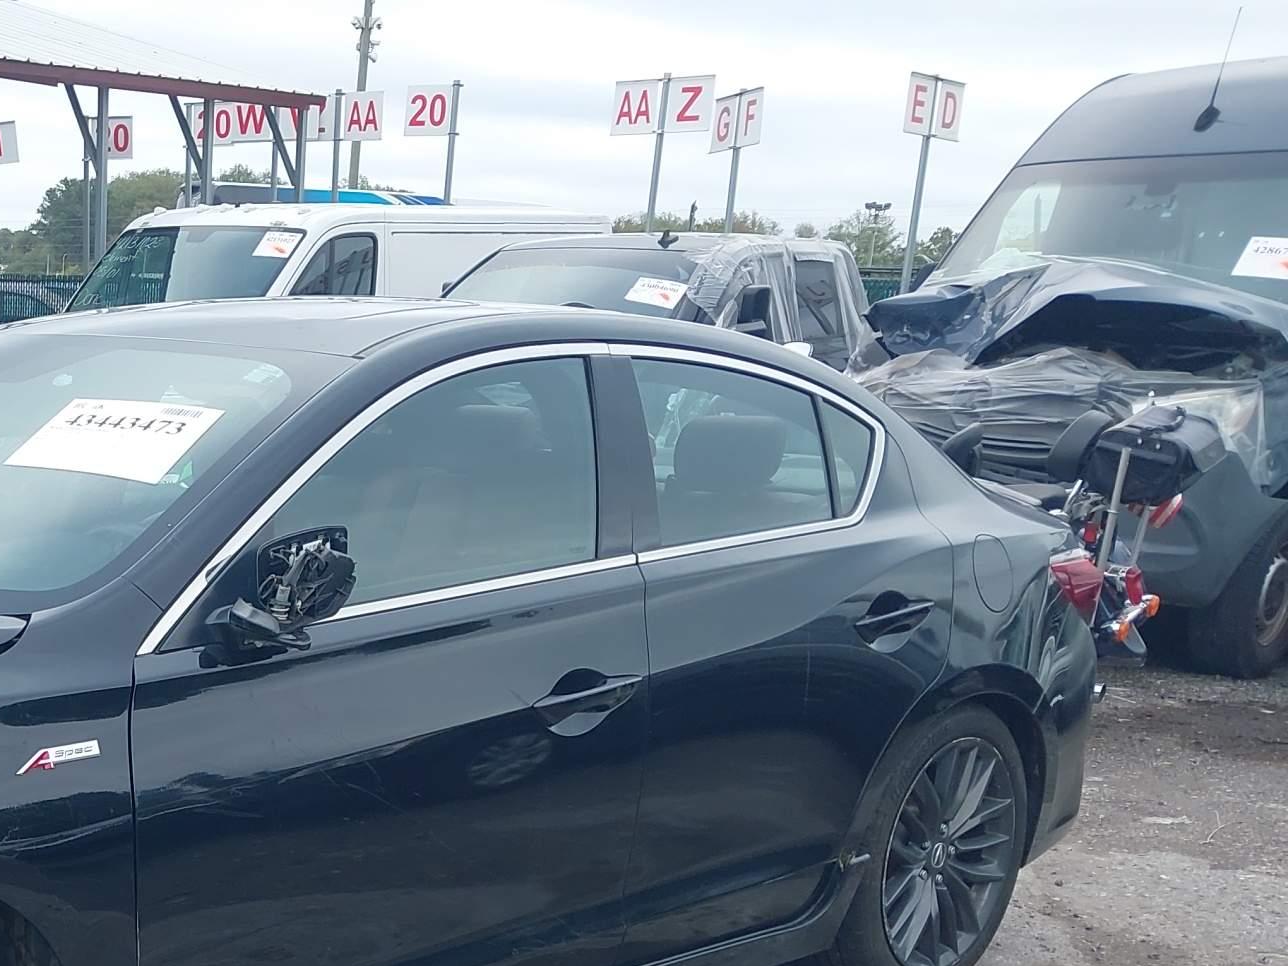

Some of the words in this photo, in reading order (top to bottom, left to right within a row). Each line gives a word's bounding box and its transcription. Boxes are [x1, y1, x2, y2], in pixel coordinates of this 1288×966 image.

[236, 104, 265, 135] W
[347, 100, 379, 132] AA
[408, 94, 447, 127] 20
[615, 89, 651, 126] AA
[676, 86, 703, 122] Z
[744, 98, 758, 137] F
[911, 84, 928, 124] E
[941, 91, 957, 129] D
[107, 123, 130, 153] 0
[717, 106, 731, 142] G
[64, 413, 187, 436] 43443473
